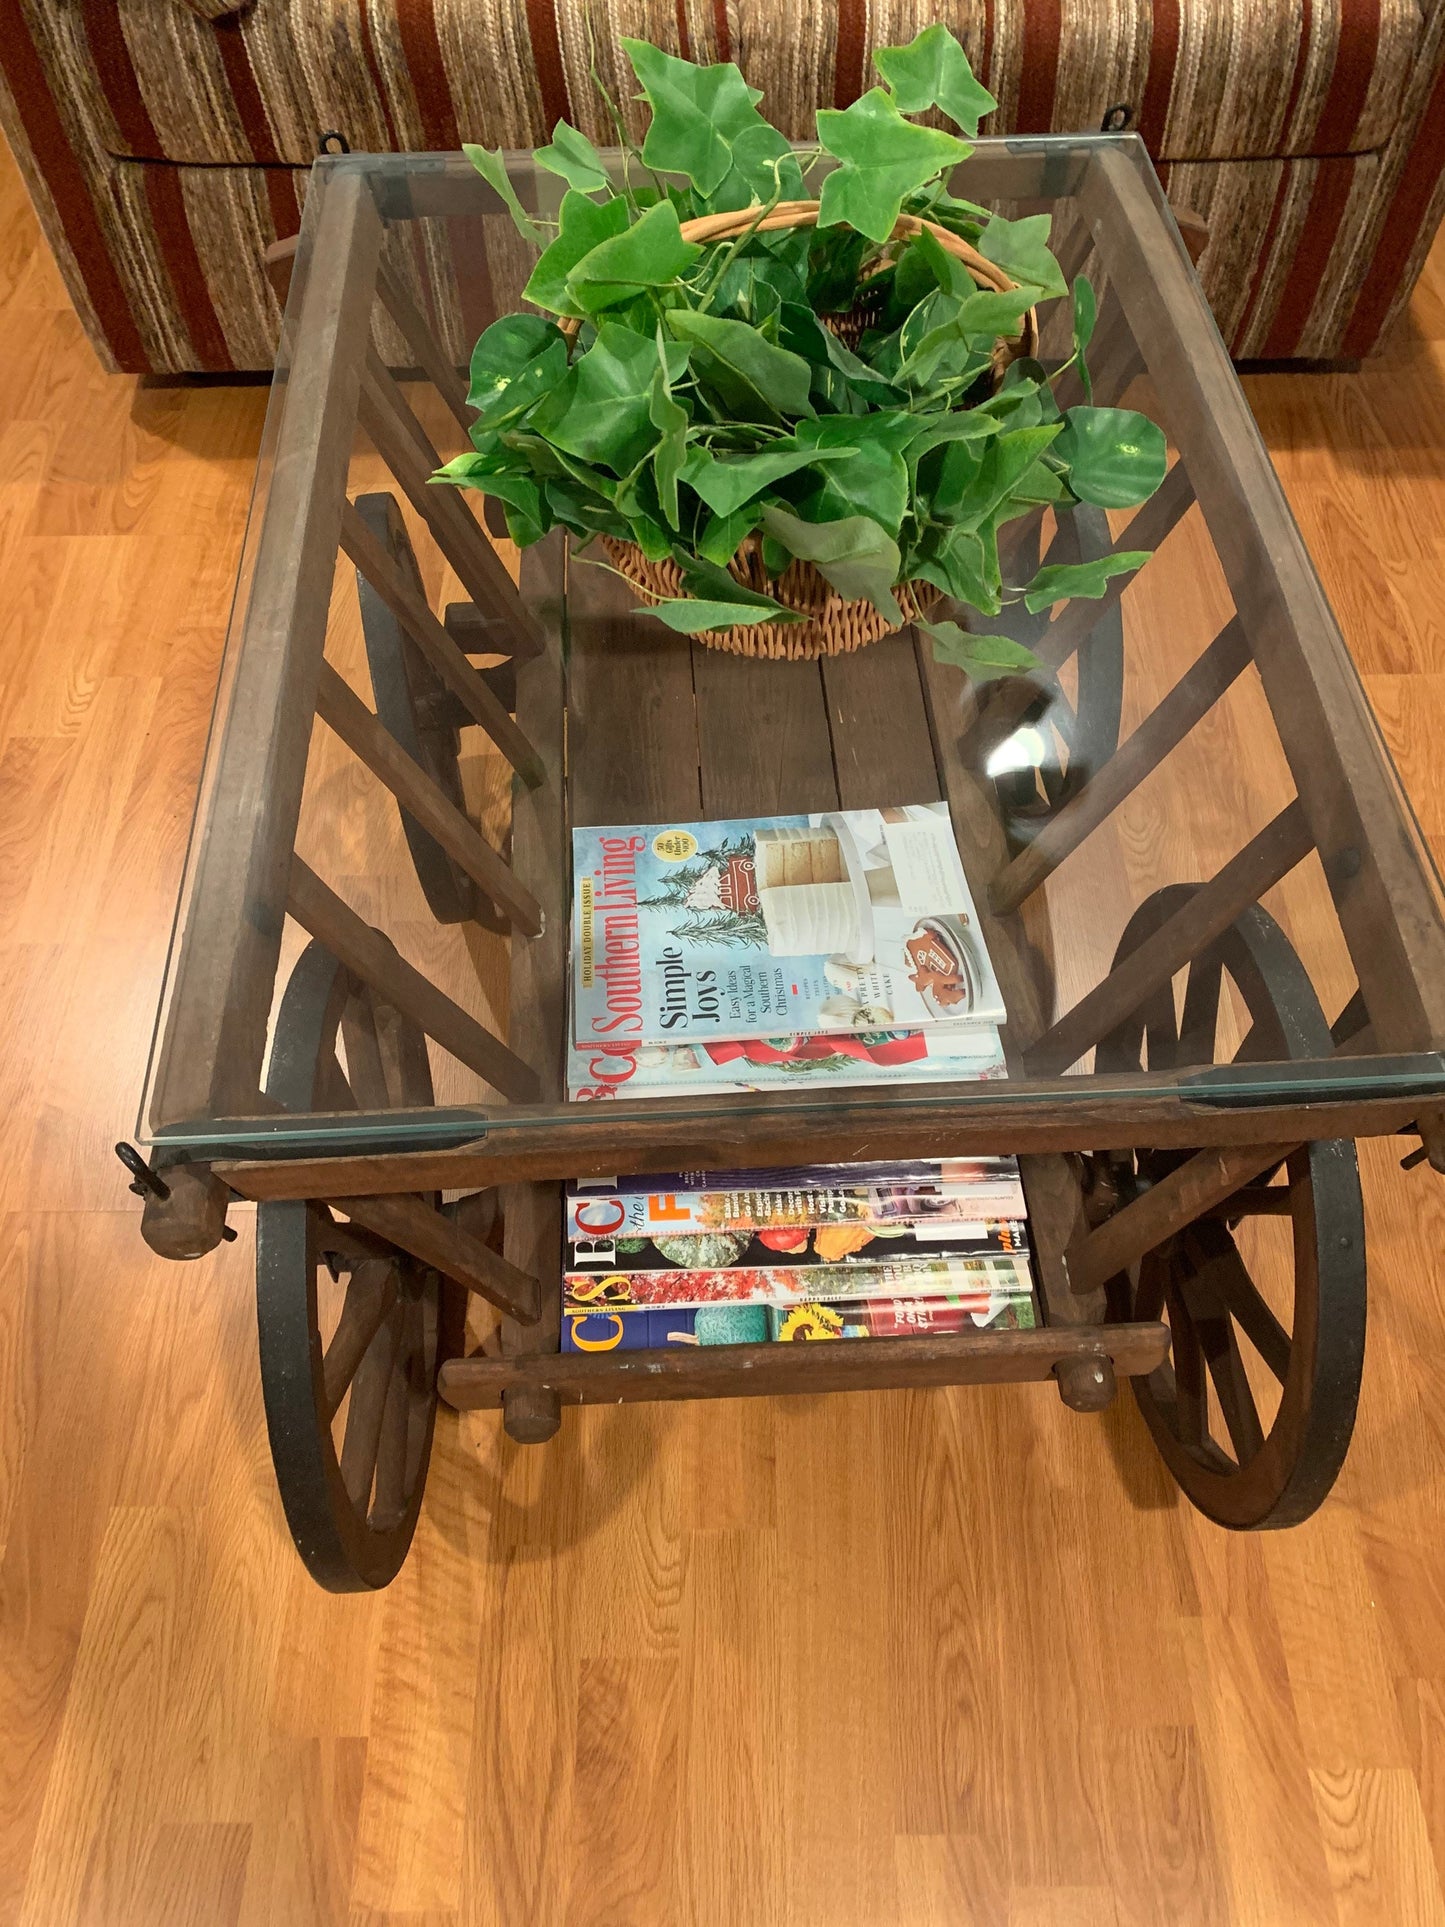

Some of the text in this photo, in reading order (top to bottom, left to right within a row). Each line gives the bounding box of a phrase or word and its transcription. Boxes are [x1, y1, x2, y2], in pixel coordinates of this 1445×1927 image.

[657, 842, 666, 852] 50
[665, 839, 673, 854] Gifts
[673, 836, 682, 856] Under
[682, 838, 690, 853] $100
[593, 836, 646, 911] Living
[582, 883, 593, 982] HOLIDAY DOUBLE ISSUE
[592, 913, 643, 1033] Southern
[739, 965, 756, 998] Magical
[882, 973, 893, 996] CAKE
[656, 946, 692, 1029] Simple
[692, 970, 726, 1023] Joys
[726, 970, 742, 1019] Easy Ideas
[758, 971, 772, 1014] Southern
[774, 967, 788, 1016] Christmas
[869, 973, 880, 999] WHITE
[745, 1009, 757, 1023] for
[724, 1198, 732, 1218] Bake
[744, 1206, 751, 1217] Go
[775, 1194, 783, 1216] Make
[794, 1195, 803, 1215] with
[806, 1194, 815, 1214] Host
[818, 1194, 826, 1214] Visit
[839, 1200, 847, 1213] Go
[628, 1203, 645, 1233] the
[1009, 1220, 1022, 1247] MAKE
